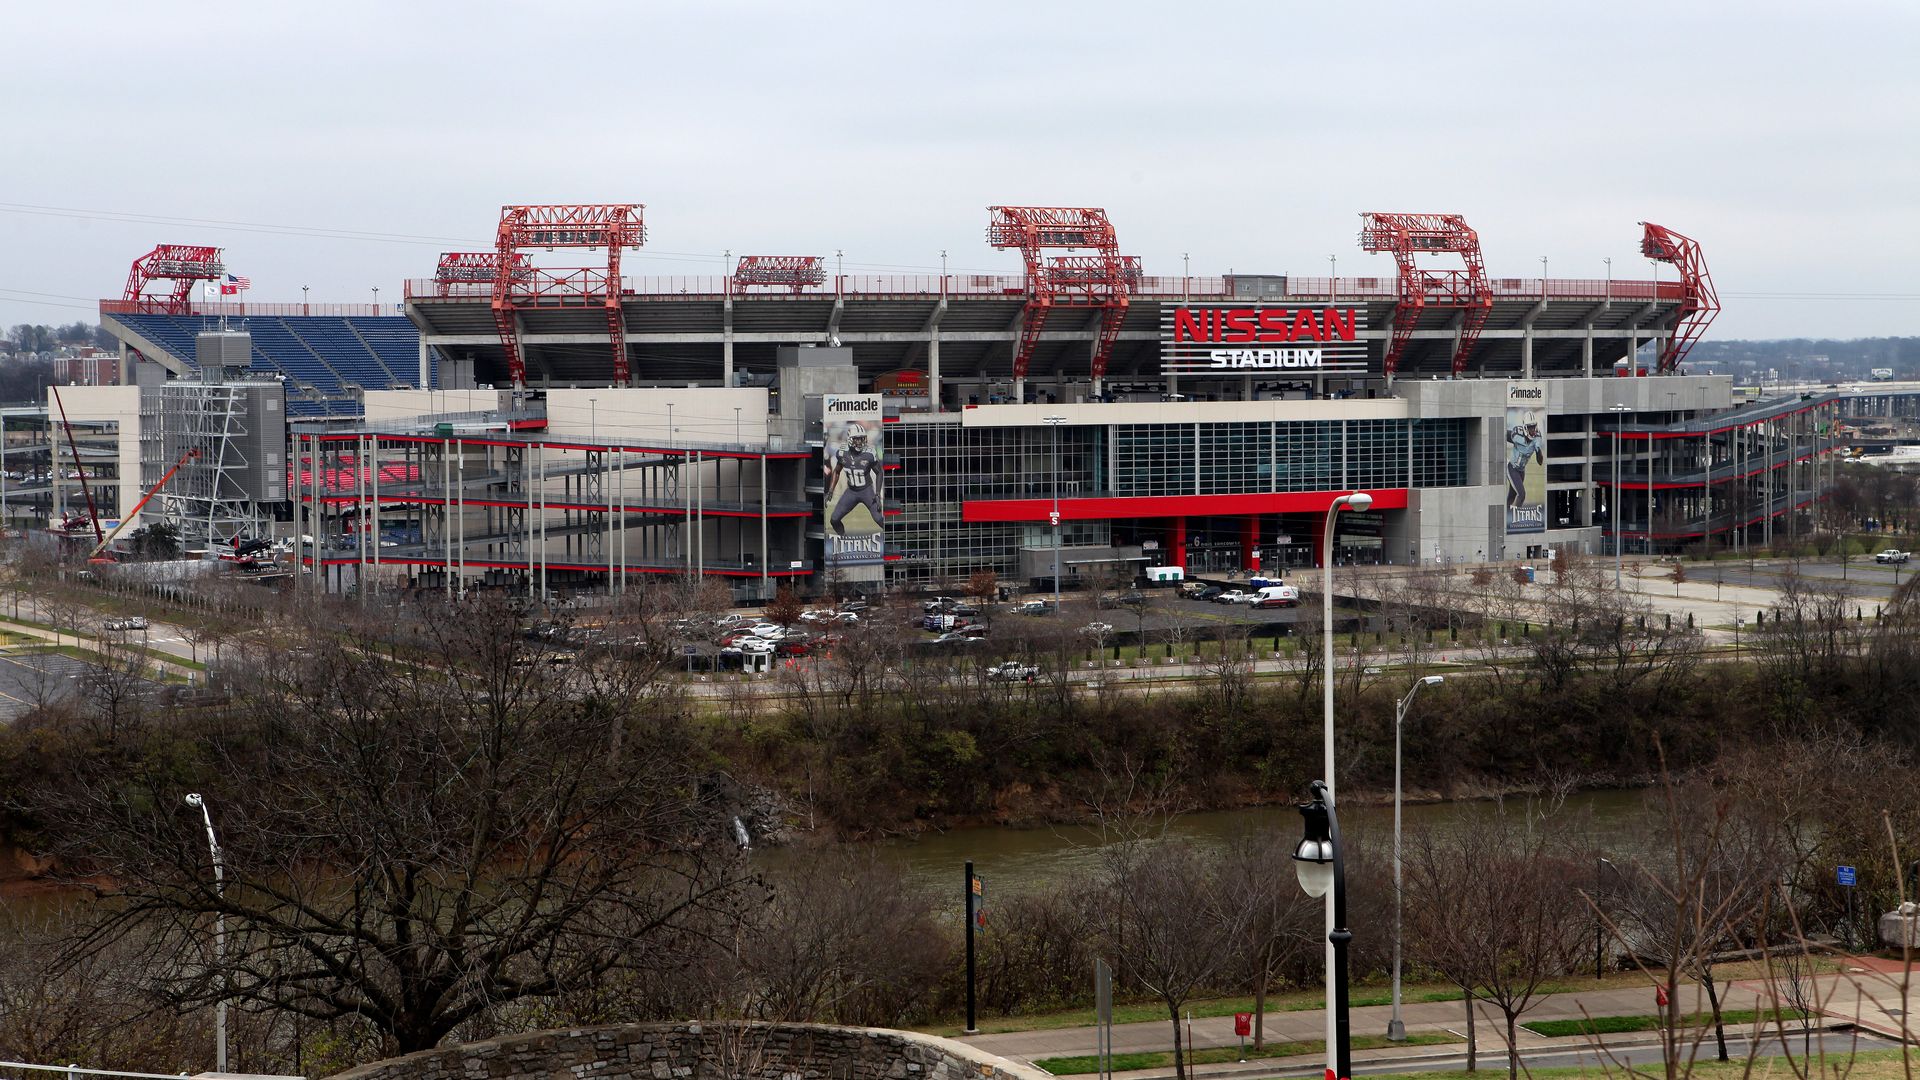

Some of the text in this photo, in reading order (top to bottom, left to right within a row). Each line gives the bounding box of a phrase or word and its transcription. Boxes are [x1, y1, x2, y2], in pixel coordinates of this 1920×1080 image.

[1174, 308, 1356, 342] NISSAN
[1210, 349, 1322, 368] STADIUM
[1511, 387, 1542, 398] Pinnacle
[828, 398, 878, 412] Pinnacle
[1051, 517, 1058, 526] S
